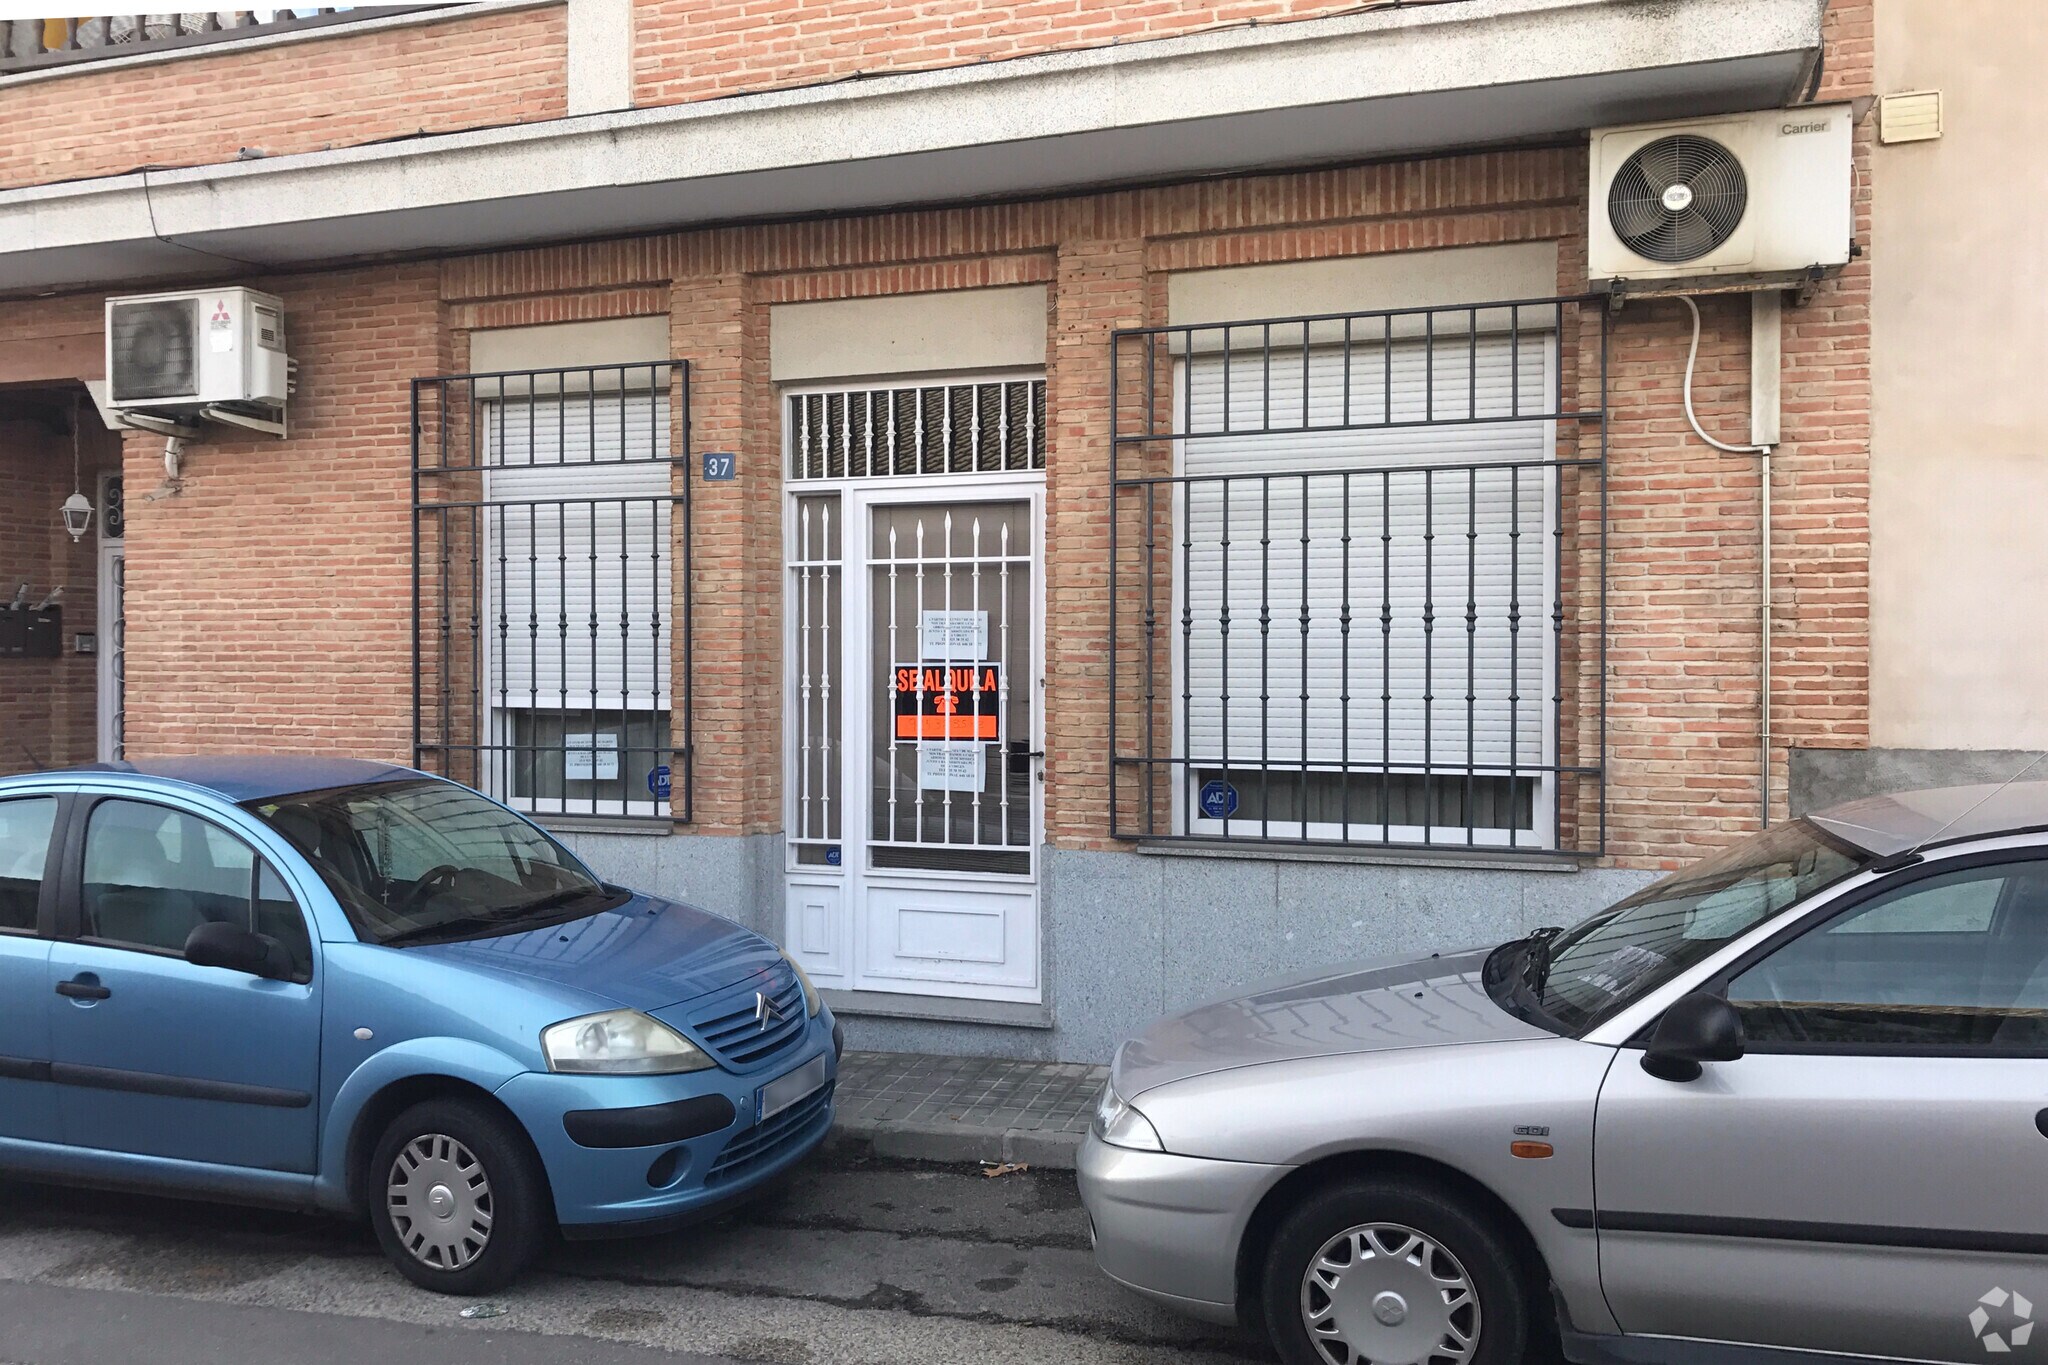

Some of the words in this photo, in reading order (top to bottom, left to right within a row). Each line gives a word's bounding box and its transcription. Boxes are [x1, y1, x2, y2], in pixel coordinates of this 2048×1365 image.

[1782, 122, 1827, 135] Carrier
[708, 457, 730, 476] 37
[897, 669, 919, 692] SE
[923, 669, 997, 693] ALQUIA
[1513, 1125, 1550, 1136] GDI
